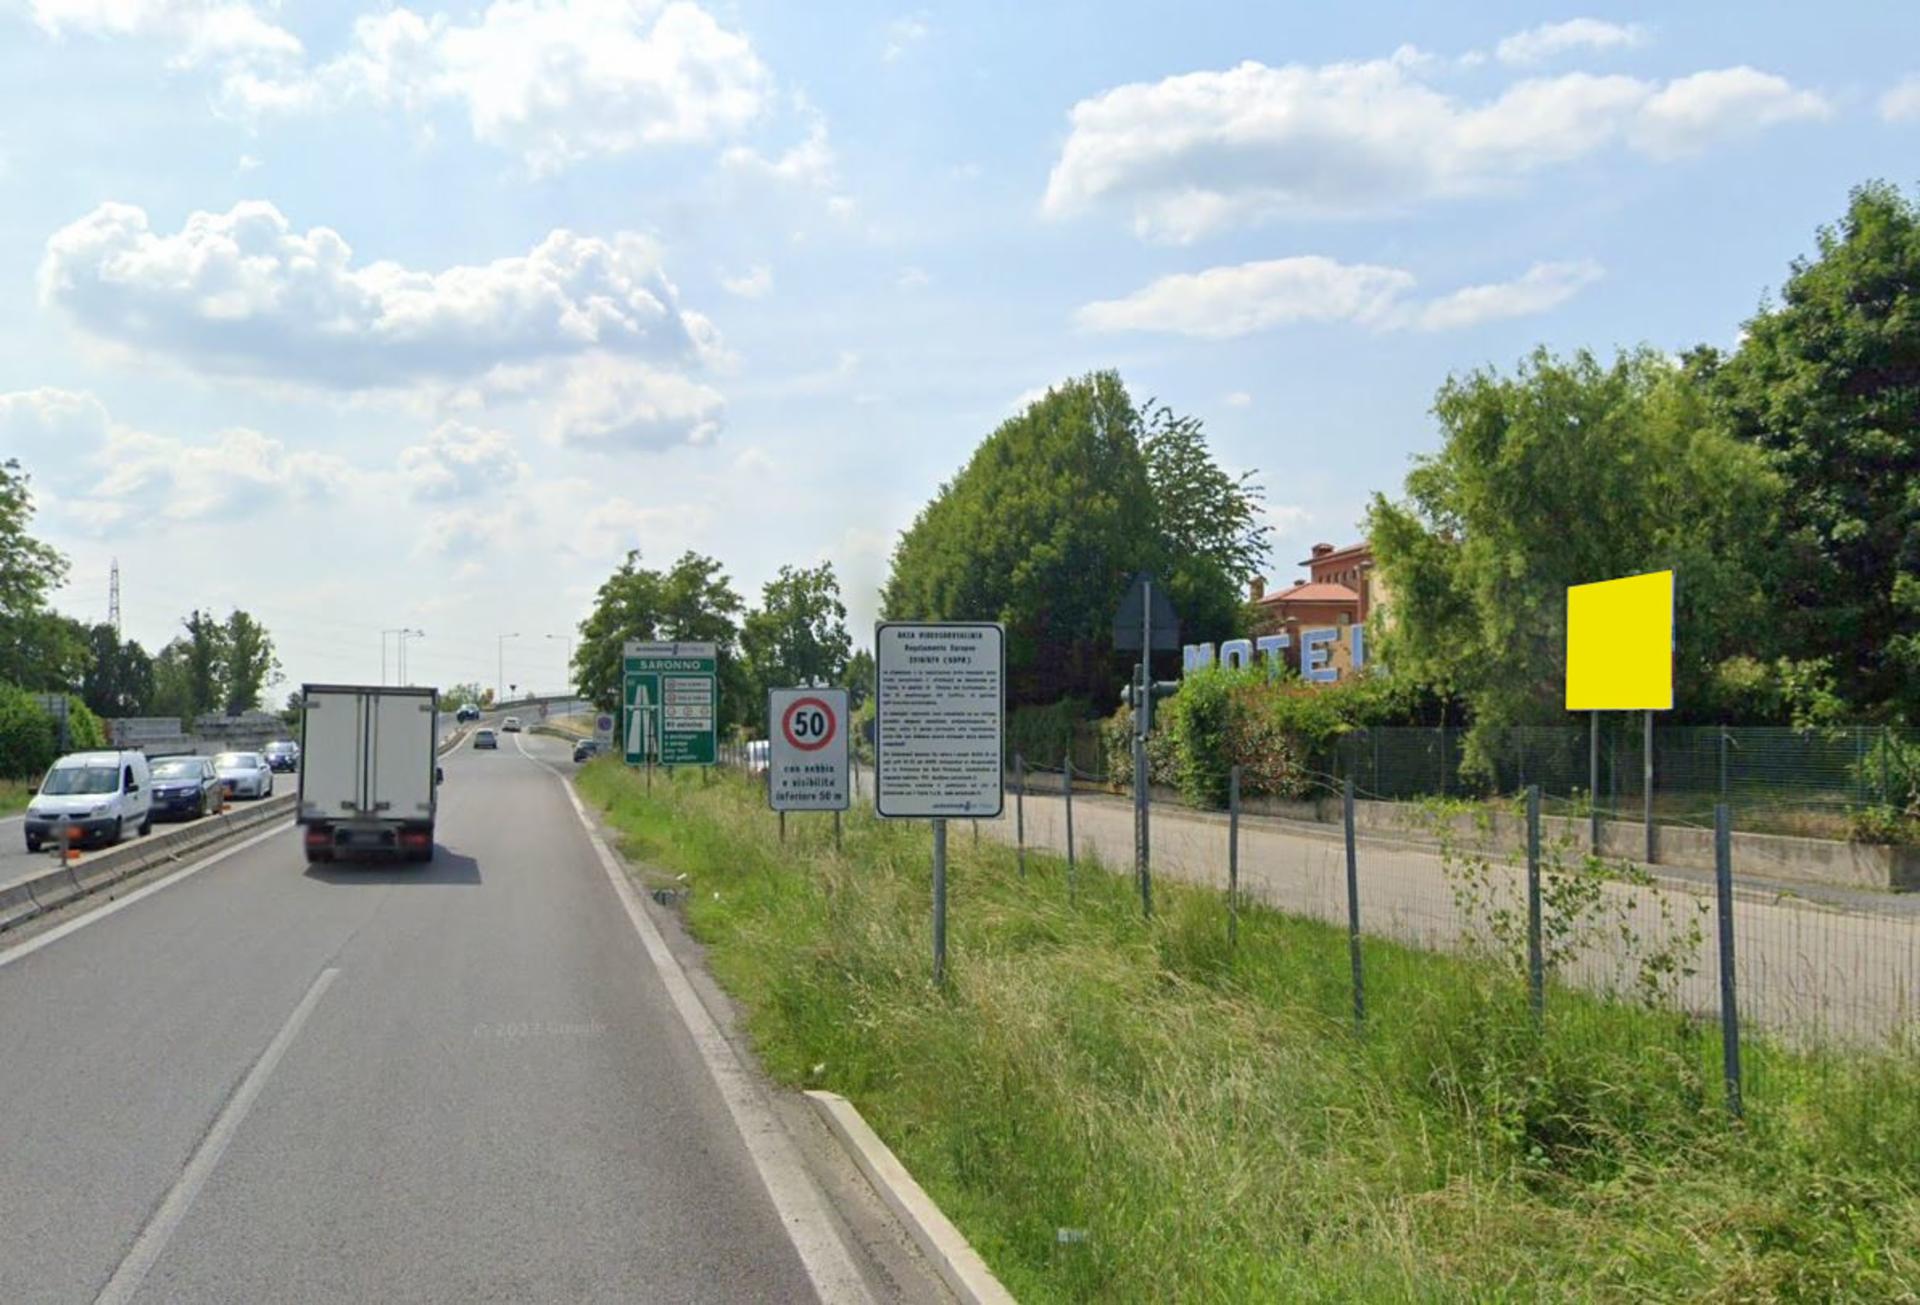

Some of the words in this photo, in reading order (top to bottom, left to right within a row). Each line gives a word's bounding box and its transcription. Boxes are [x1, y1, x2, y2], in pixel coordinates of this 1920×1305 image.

[640, 660, 701, 670] SARONNO
[794, 711, 824, 737] 50
[804, 764, 834, 773] nebbia
[775, 791, 817, 801] inferiore
[819, 791, 831, 801] 50
[833, 793, 843, 801] m
